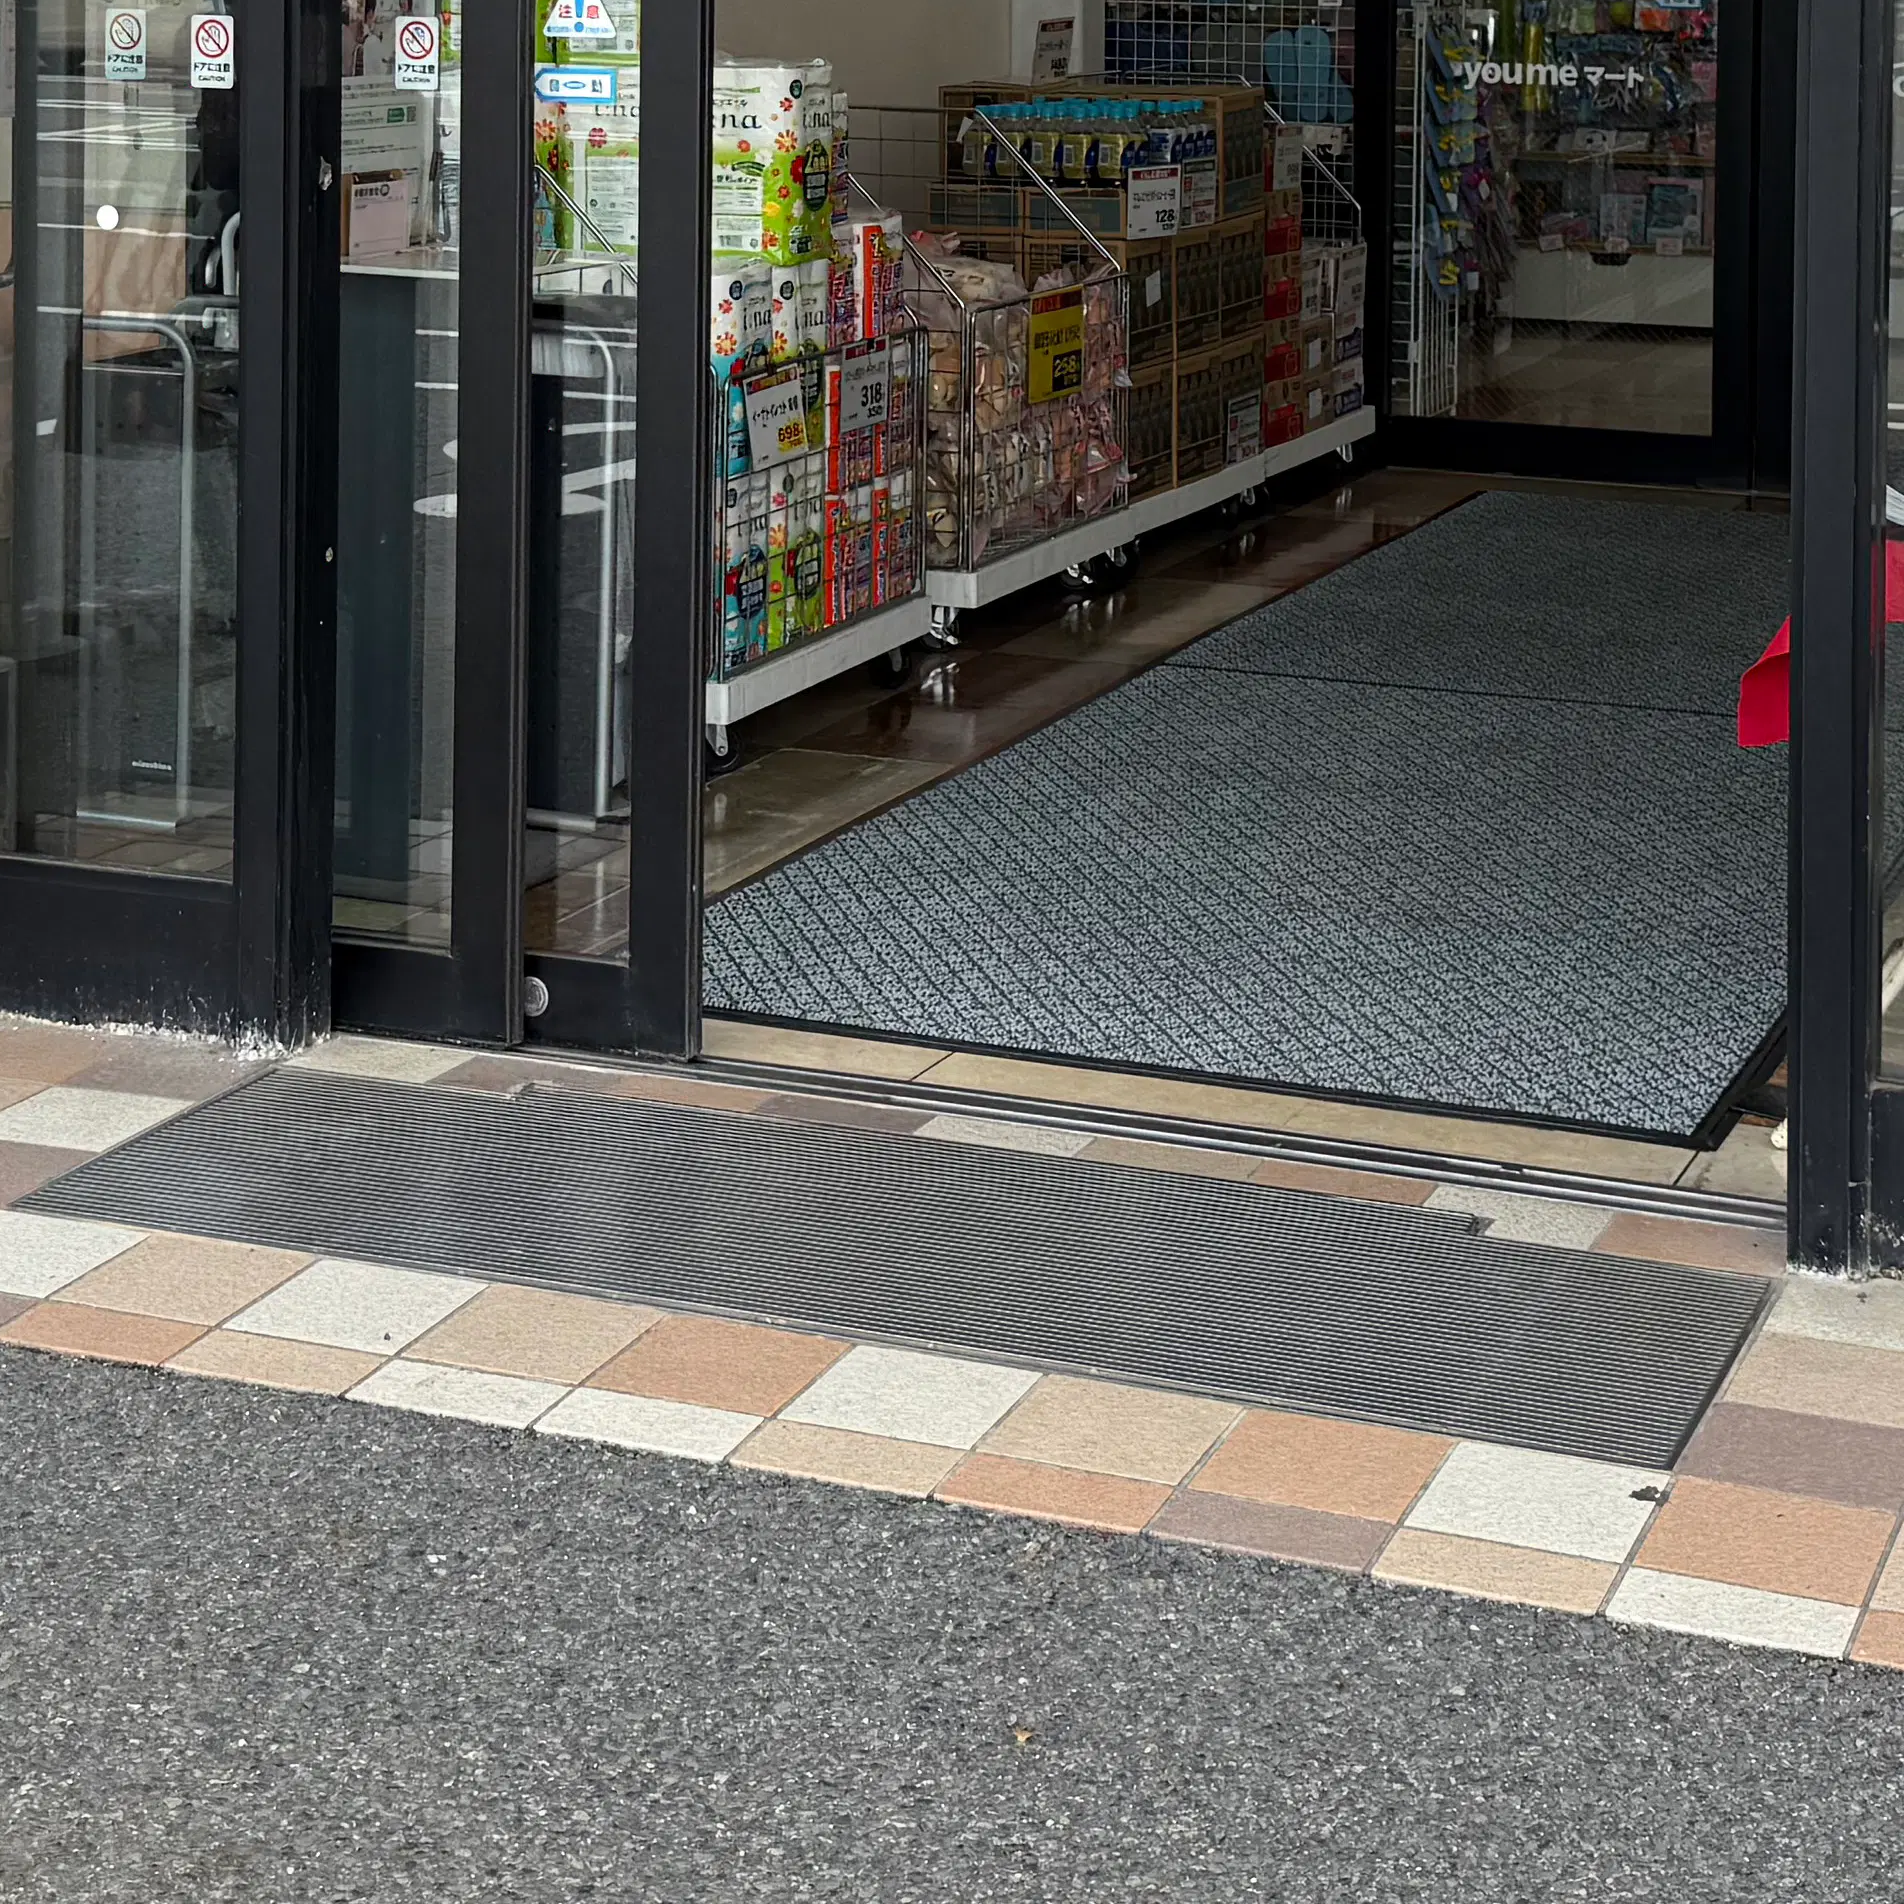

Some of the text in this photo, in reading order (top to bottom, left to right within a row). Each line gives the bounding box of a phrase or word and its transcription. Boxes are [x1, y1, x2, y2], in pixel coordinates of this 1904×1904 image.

[1462, 57, 1645, 91] youme マート
